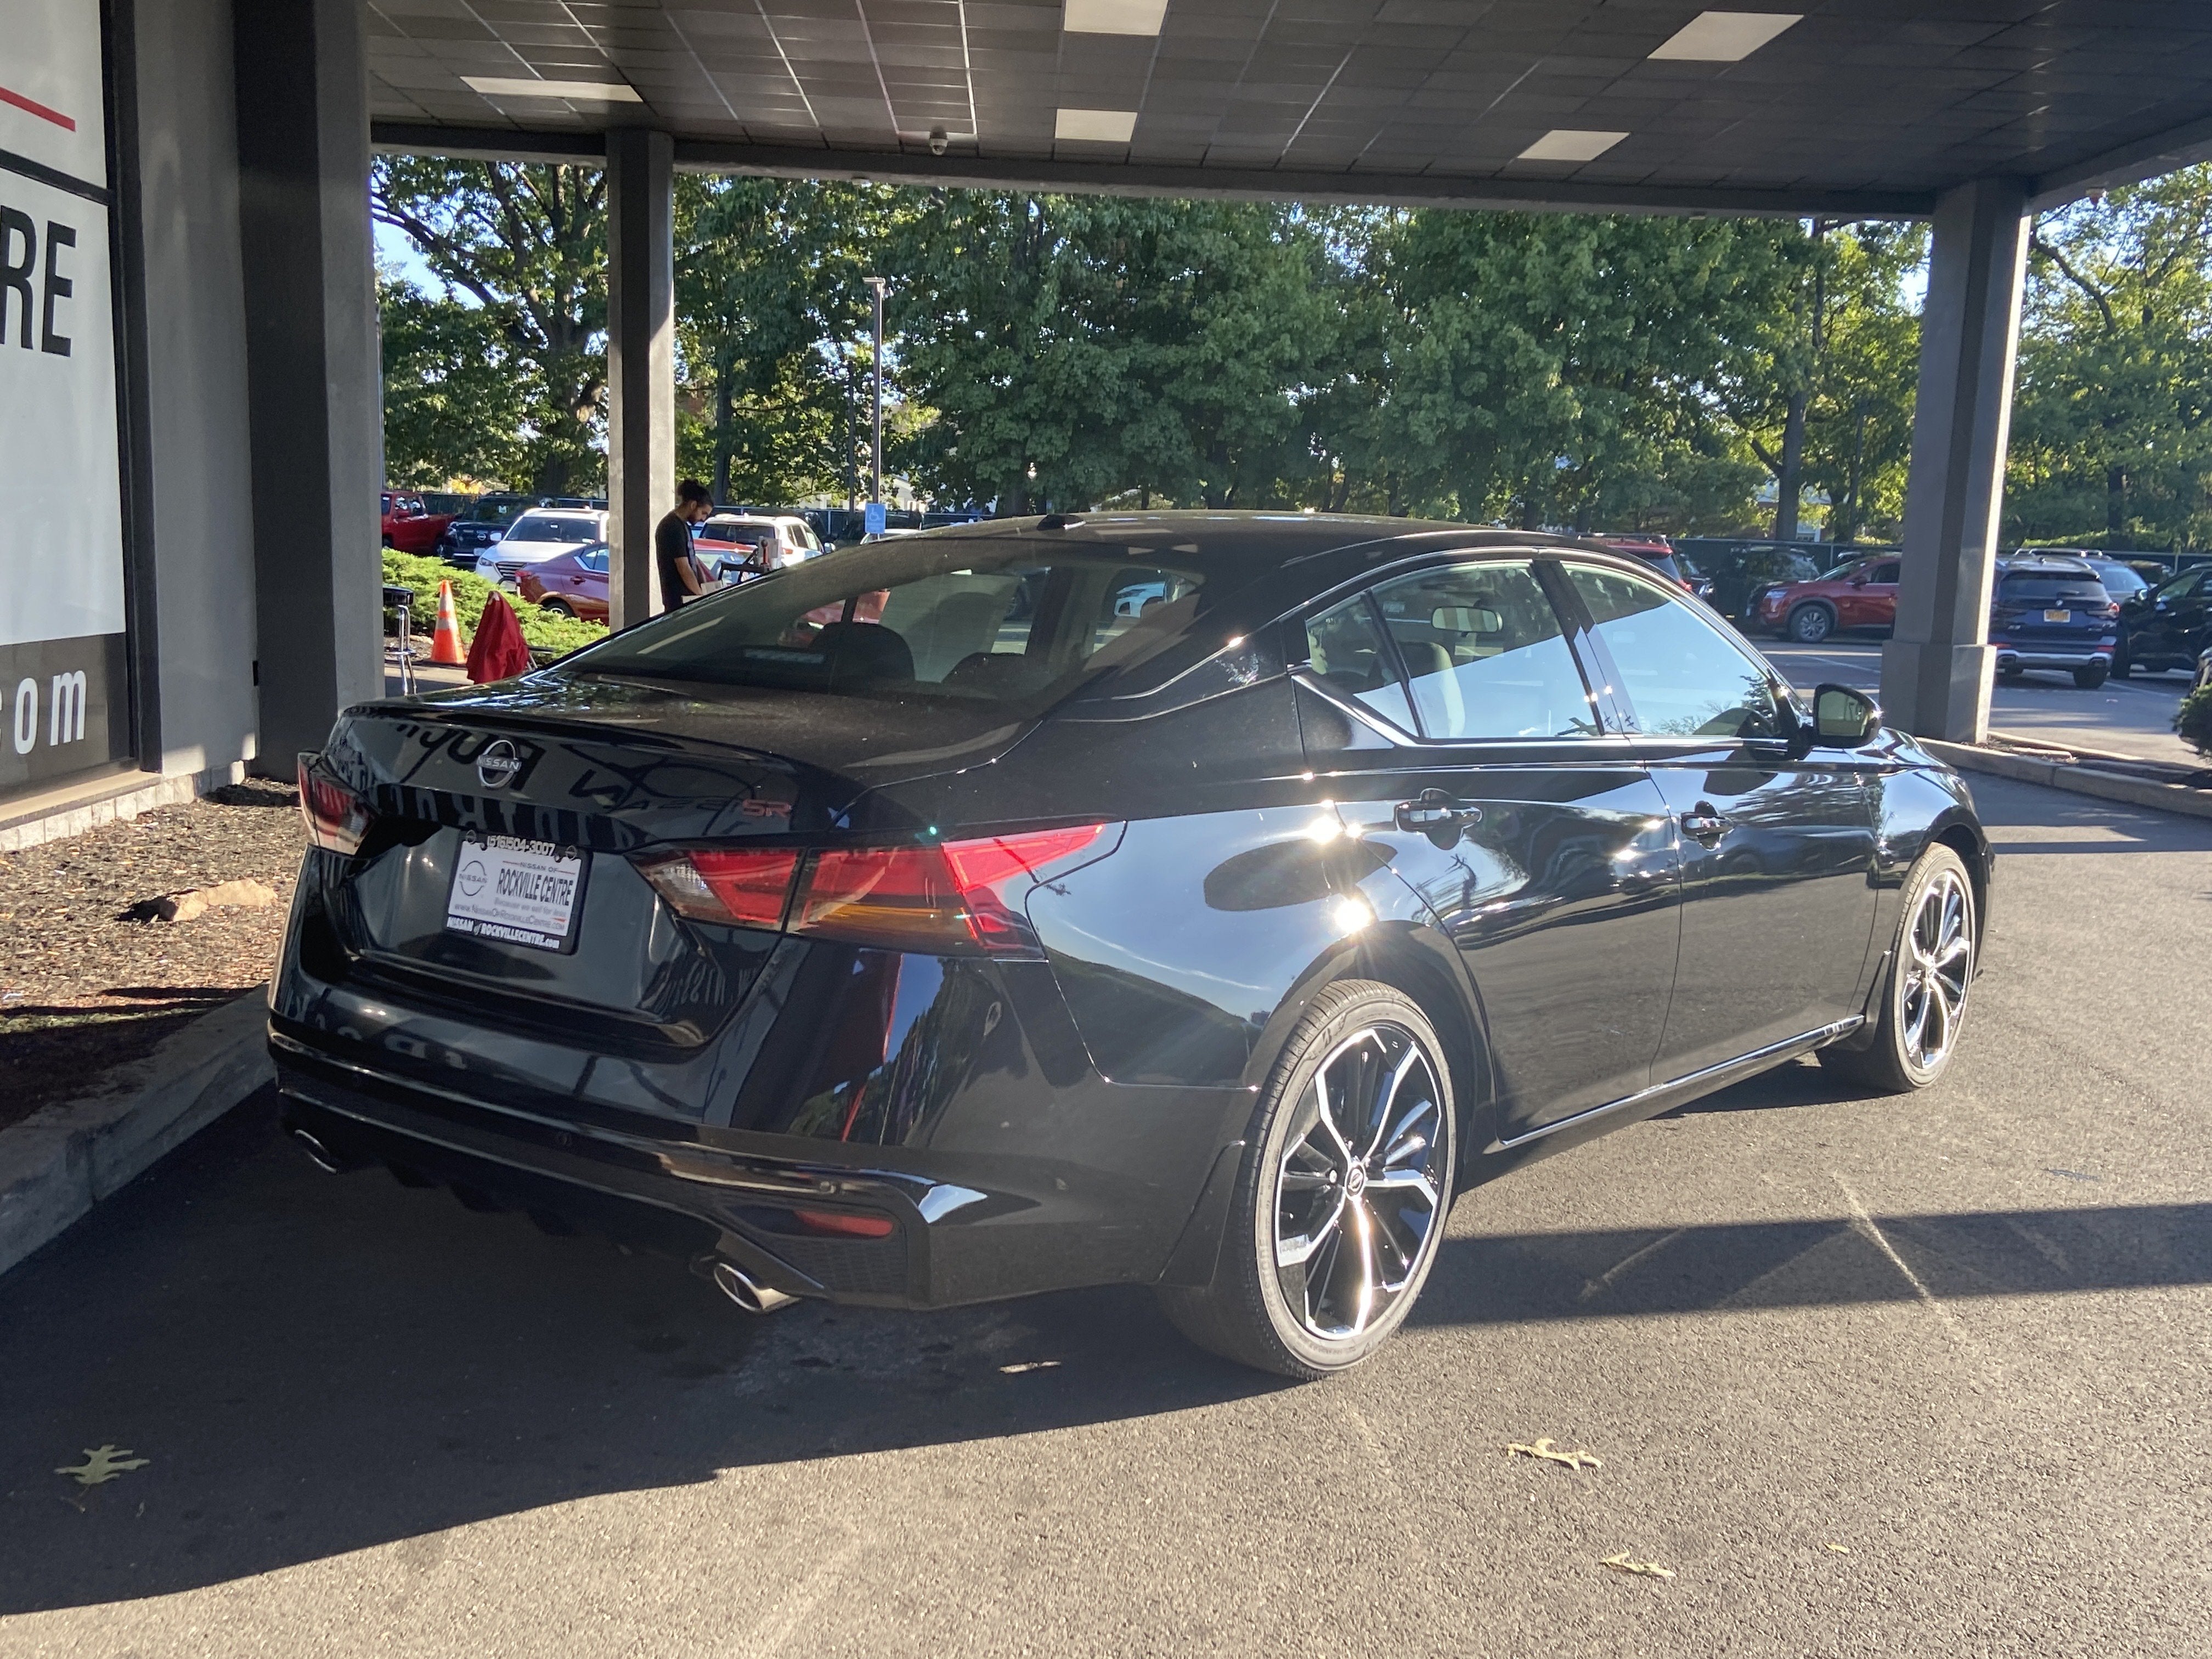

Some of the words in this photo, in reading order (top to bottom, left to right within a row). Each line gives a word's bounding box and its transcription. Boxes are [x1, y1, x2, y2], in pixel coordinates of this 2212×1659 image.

[0, 670, 87, 755] om
[742, 799, 792, 817] SR
[520, 862, 546, 871] NISSAN
[459, 873, 487, 883] NISSAN
[496, 868, 541, 900] ROCKVILLE
[540, 875, 573, 906] CENTRE
